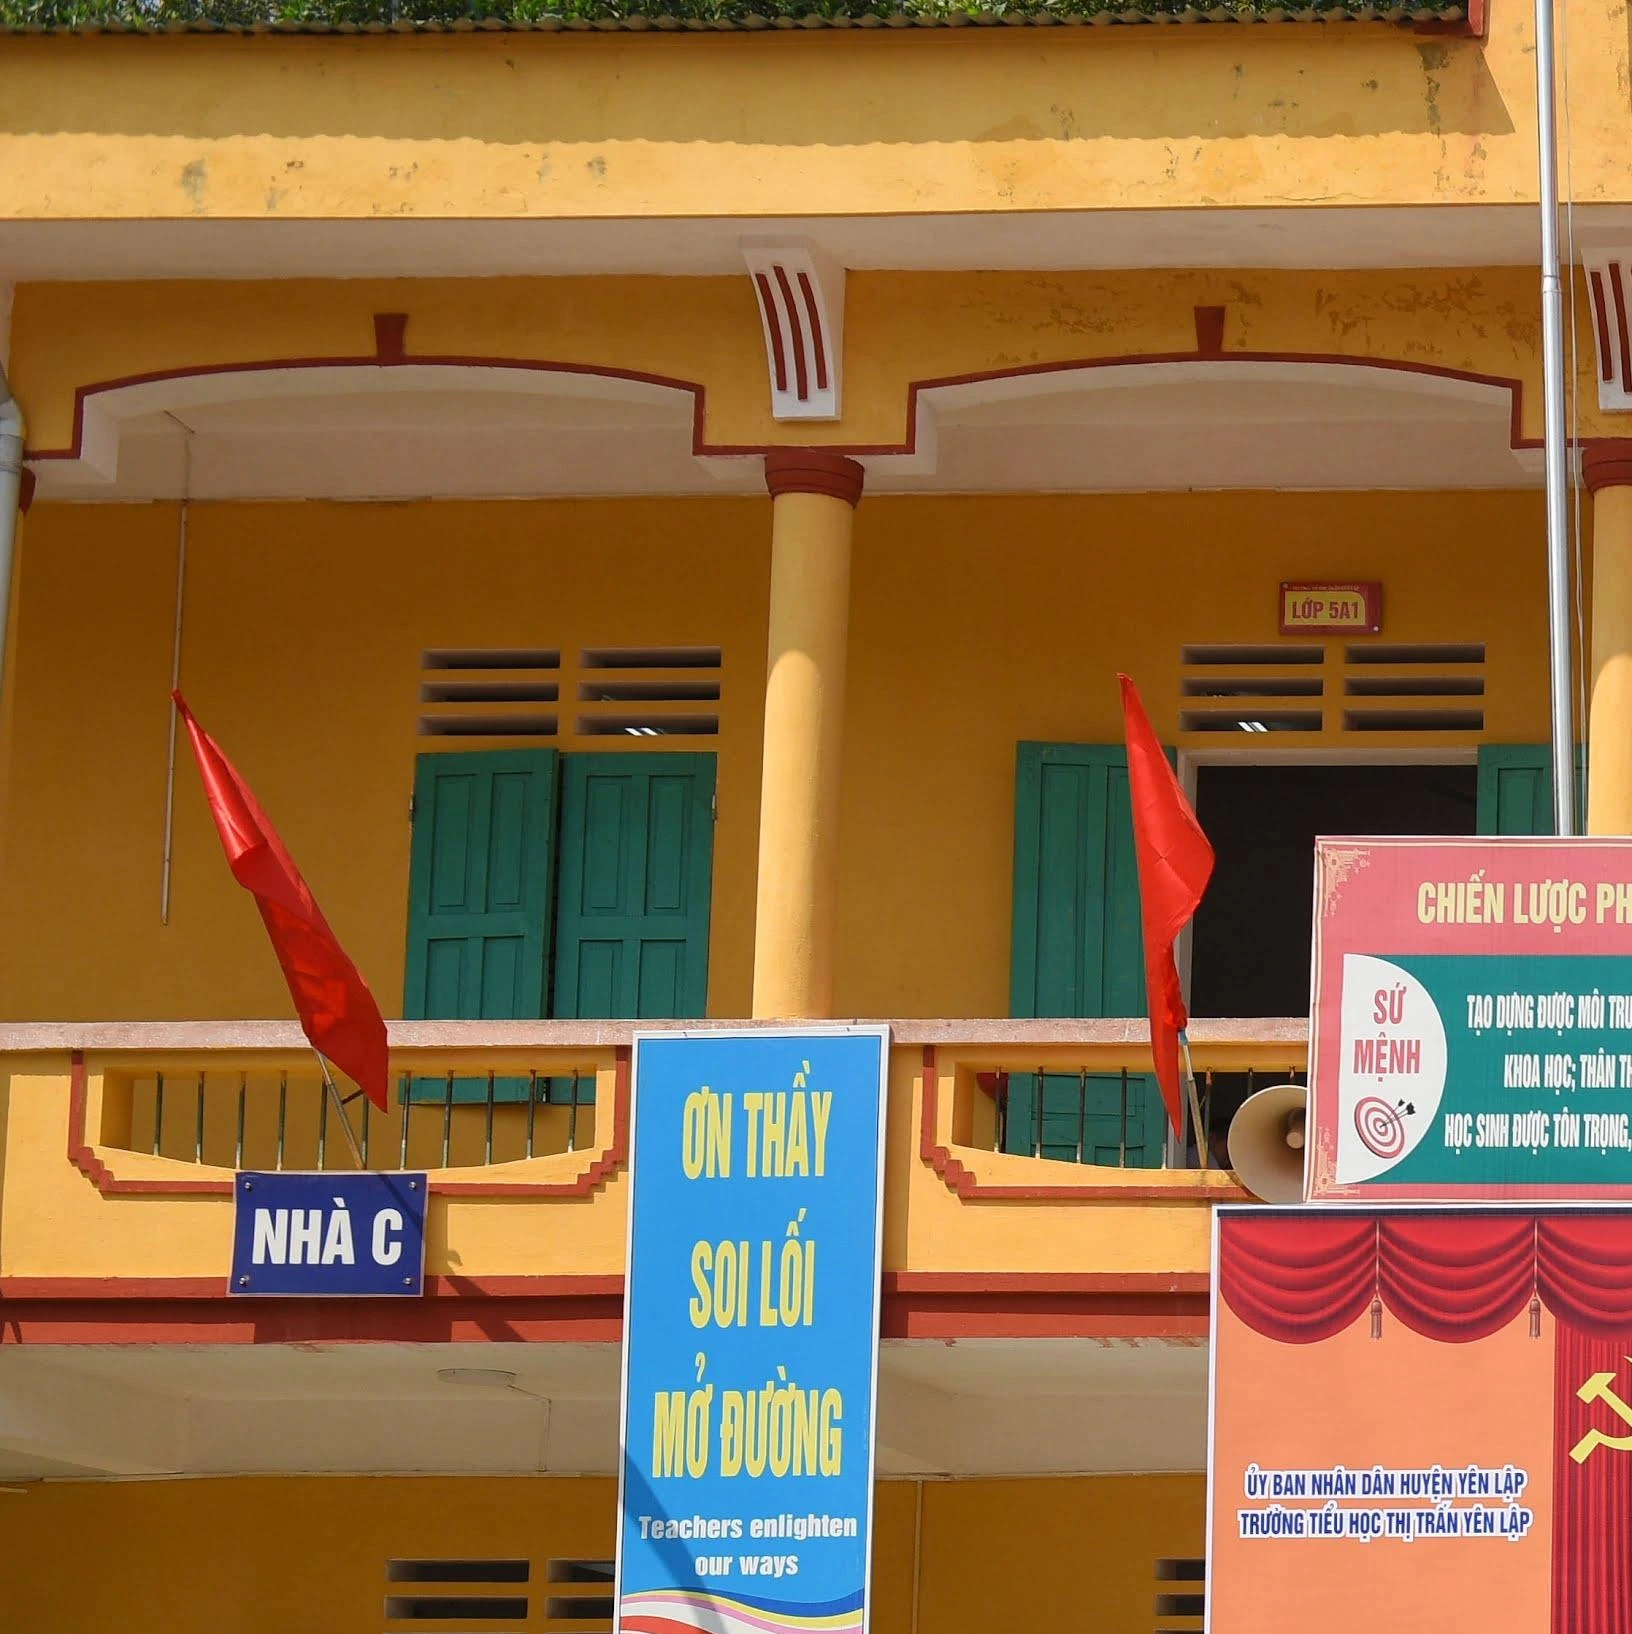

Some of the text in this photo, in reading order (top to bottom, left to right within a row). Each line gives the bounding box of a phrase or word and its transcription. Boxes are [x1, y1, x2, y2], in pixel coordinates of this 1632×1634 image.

[1292, 597, 1359, 619] LỚP 5A1
[1417, 869, 1504, 923] CHIẾN
[1514, 879, 1586, 933] LƯỢC
[1373, 982, 1407, 1024] SỨ
[1466, 994, 1493, 1036] TẠO
[1496, 992, 1534, 1036] DỰNG
[1537, 991, 1574, 1036] ĐƯỢC
[1577, 988, 1604, 1029] MÔI
[1352, 1032, 1421, 1082] MỆNH
[681, 1060, 832, 1179] ƠN THẦY
[1444, 1113, 1473, 1155] HỌC
[1475, 1113, 1510, 1148] SINH
[1512, 1110, 1550, 1155] ĐƯỢC
[1553, 1106, 1580, 1148] TÔN
[1584, 1113, 1632, 1155] TRỌNG,
[252, 1197, 403, 1266] NHÀ C
[690, 1207, 815, 1329] SOI LỐI
[652, 1351, 842, 1478] MỞ ĐƯỜNG
[1248, 1466, 1524, 1500] ỦY BAN NHÂN DÂN HUYỆN YÊN LẬP
[639, 1515, 857, 1541] Teachers enlighten
[1241, 1503, 1530, 1539] TRƯỜNG TIỂU HỌC THỊ TRẤN YÊN LẬP
[694, 1555, 799, 1579] our ways
